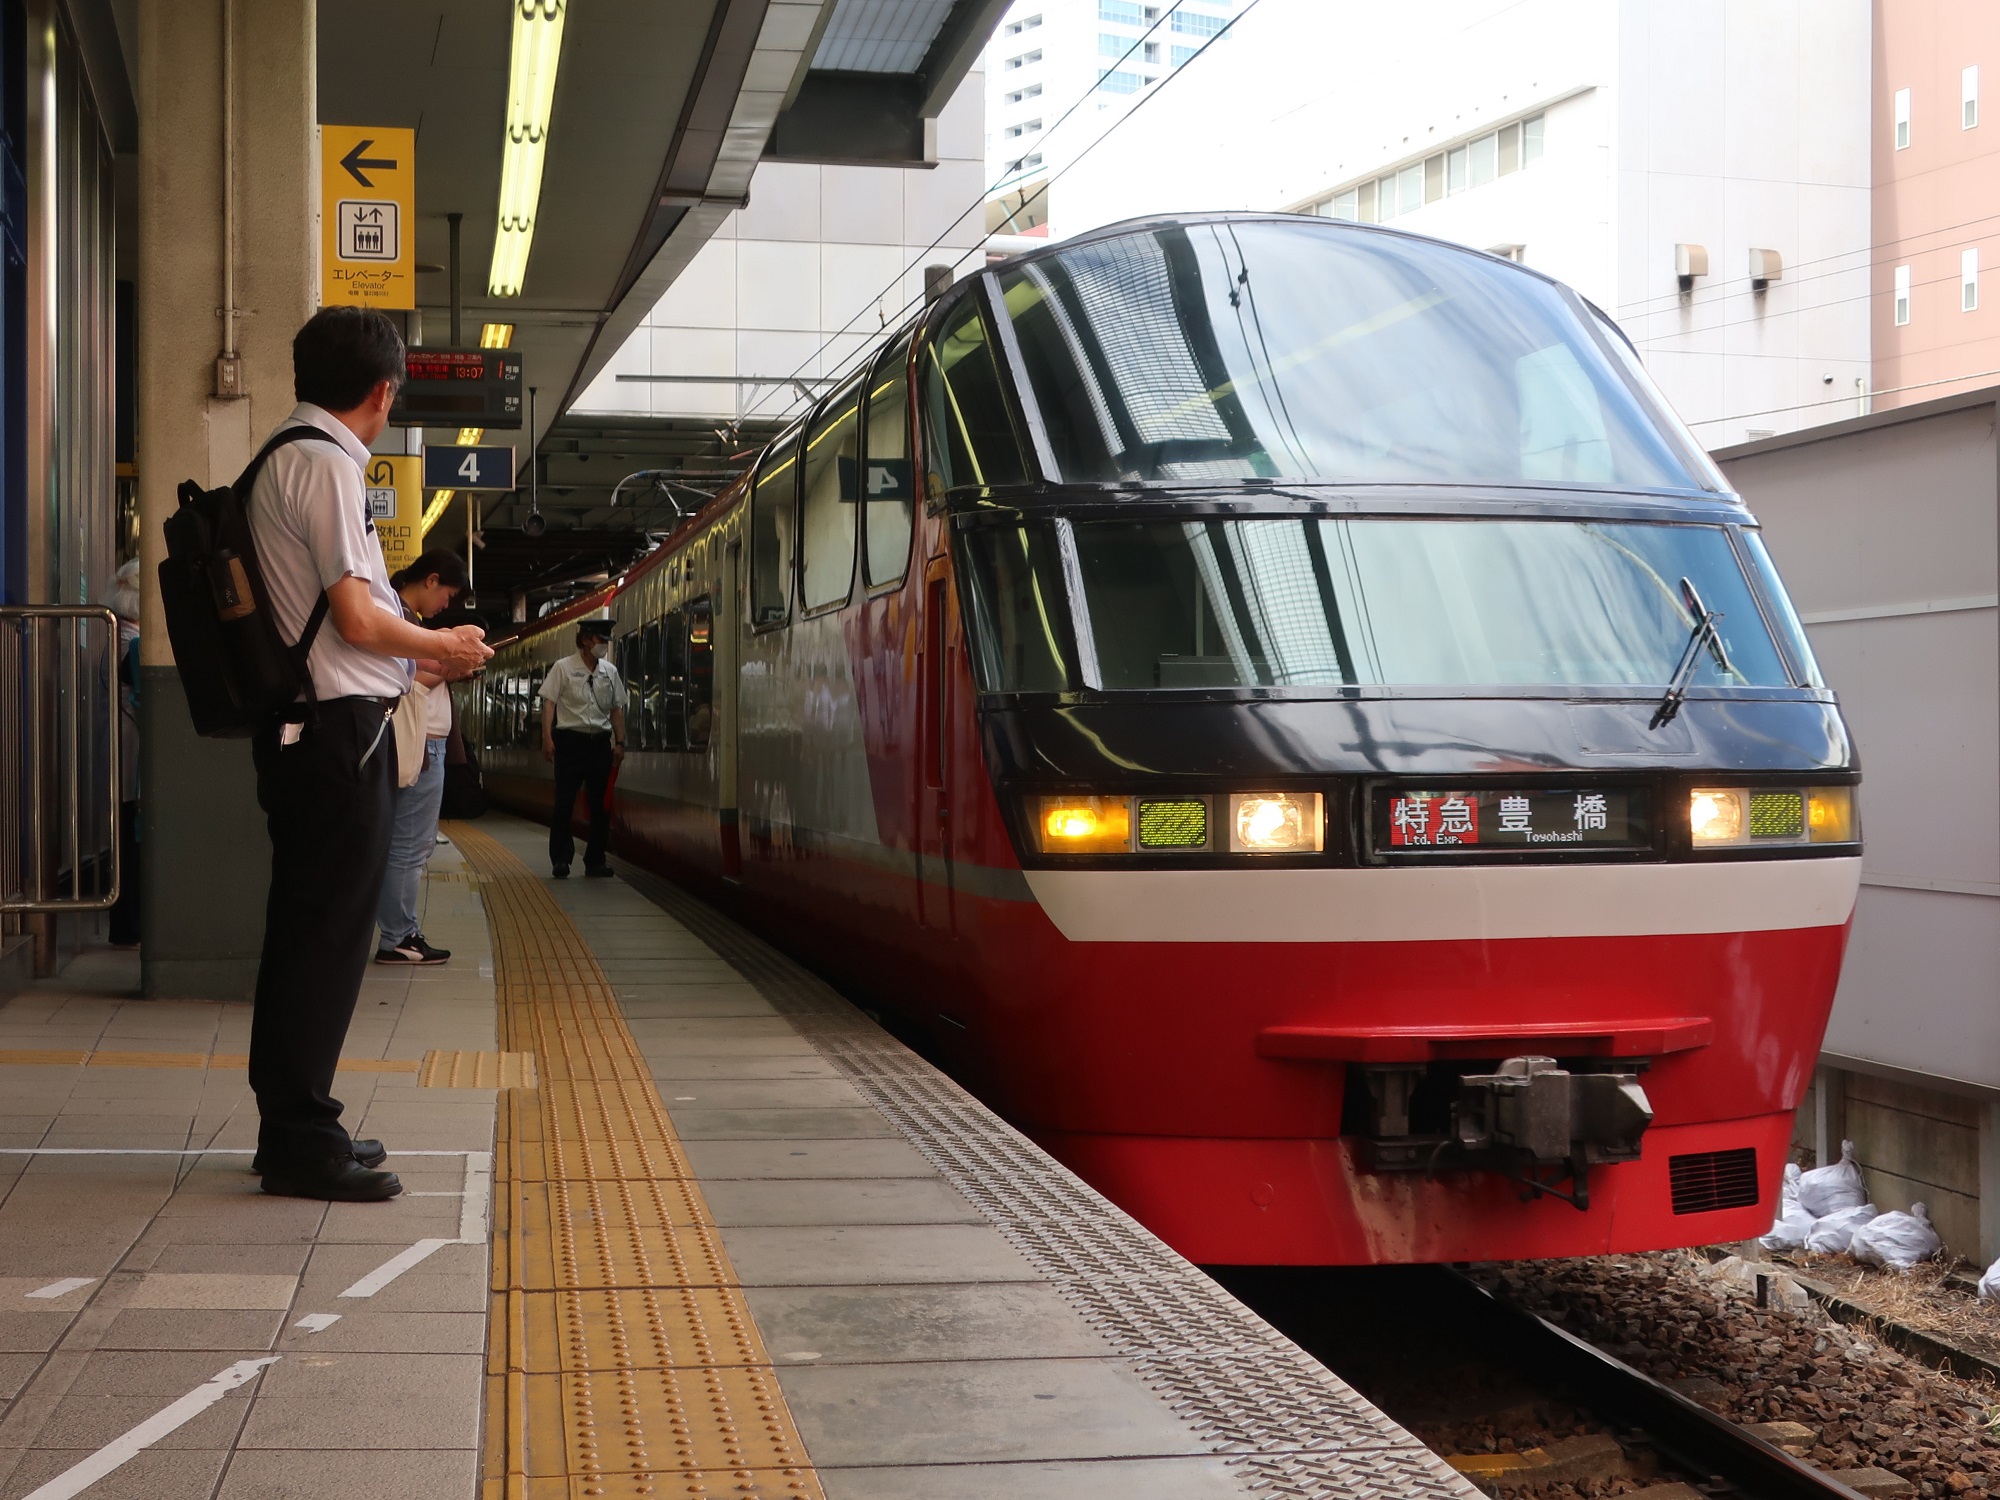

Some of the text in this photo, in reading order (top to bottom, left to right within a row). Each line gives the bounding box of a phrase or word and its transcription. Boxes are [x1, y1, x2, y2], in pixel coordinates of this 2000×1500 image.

[332, 269, 404, 281] エレベーター
[352, 281, 385, 289] Elevator
[456, 367, 483, 378] 13:07
[458, 453, 480, 482] 4
[1394, 794, 1608, 834] 特急 豊橋
[1404, 833, 1463, 845] Ltd. Exp.
[1525, 831, 1583, 843] Toyohashi
